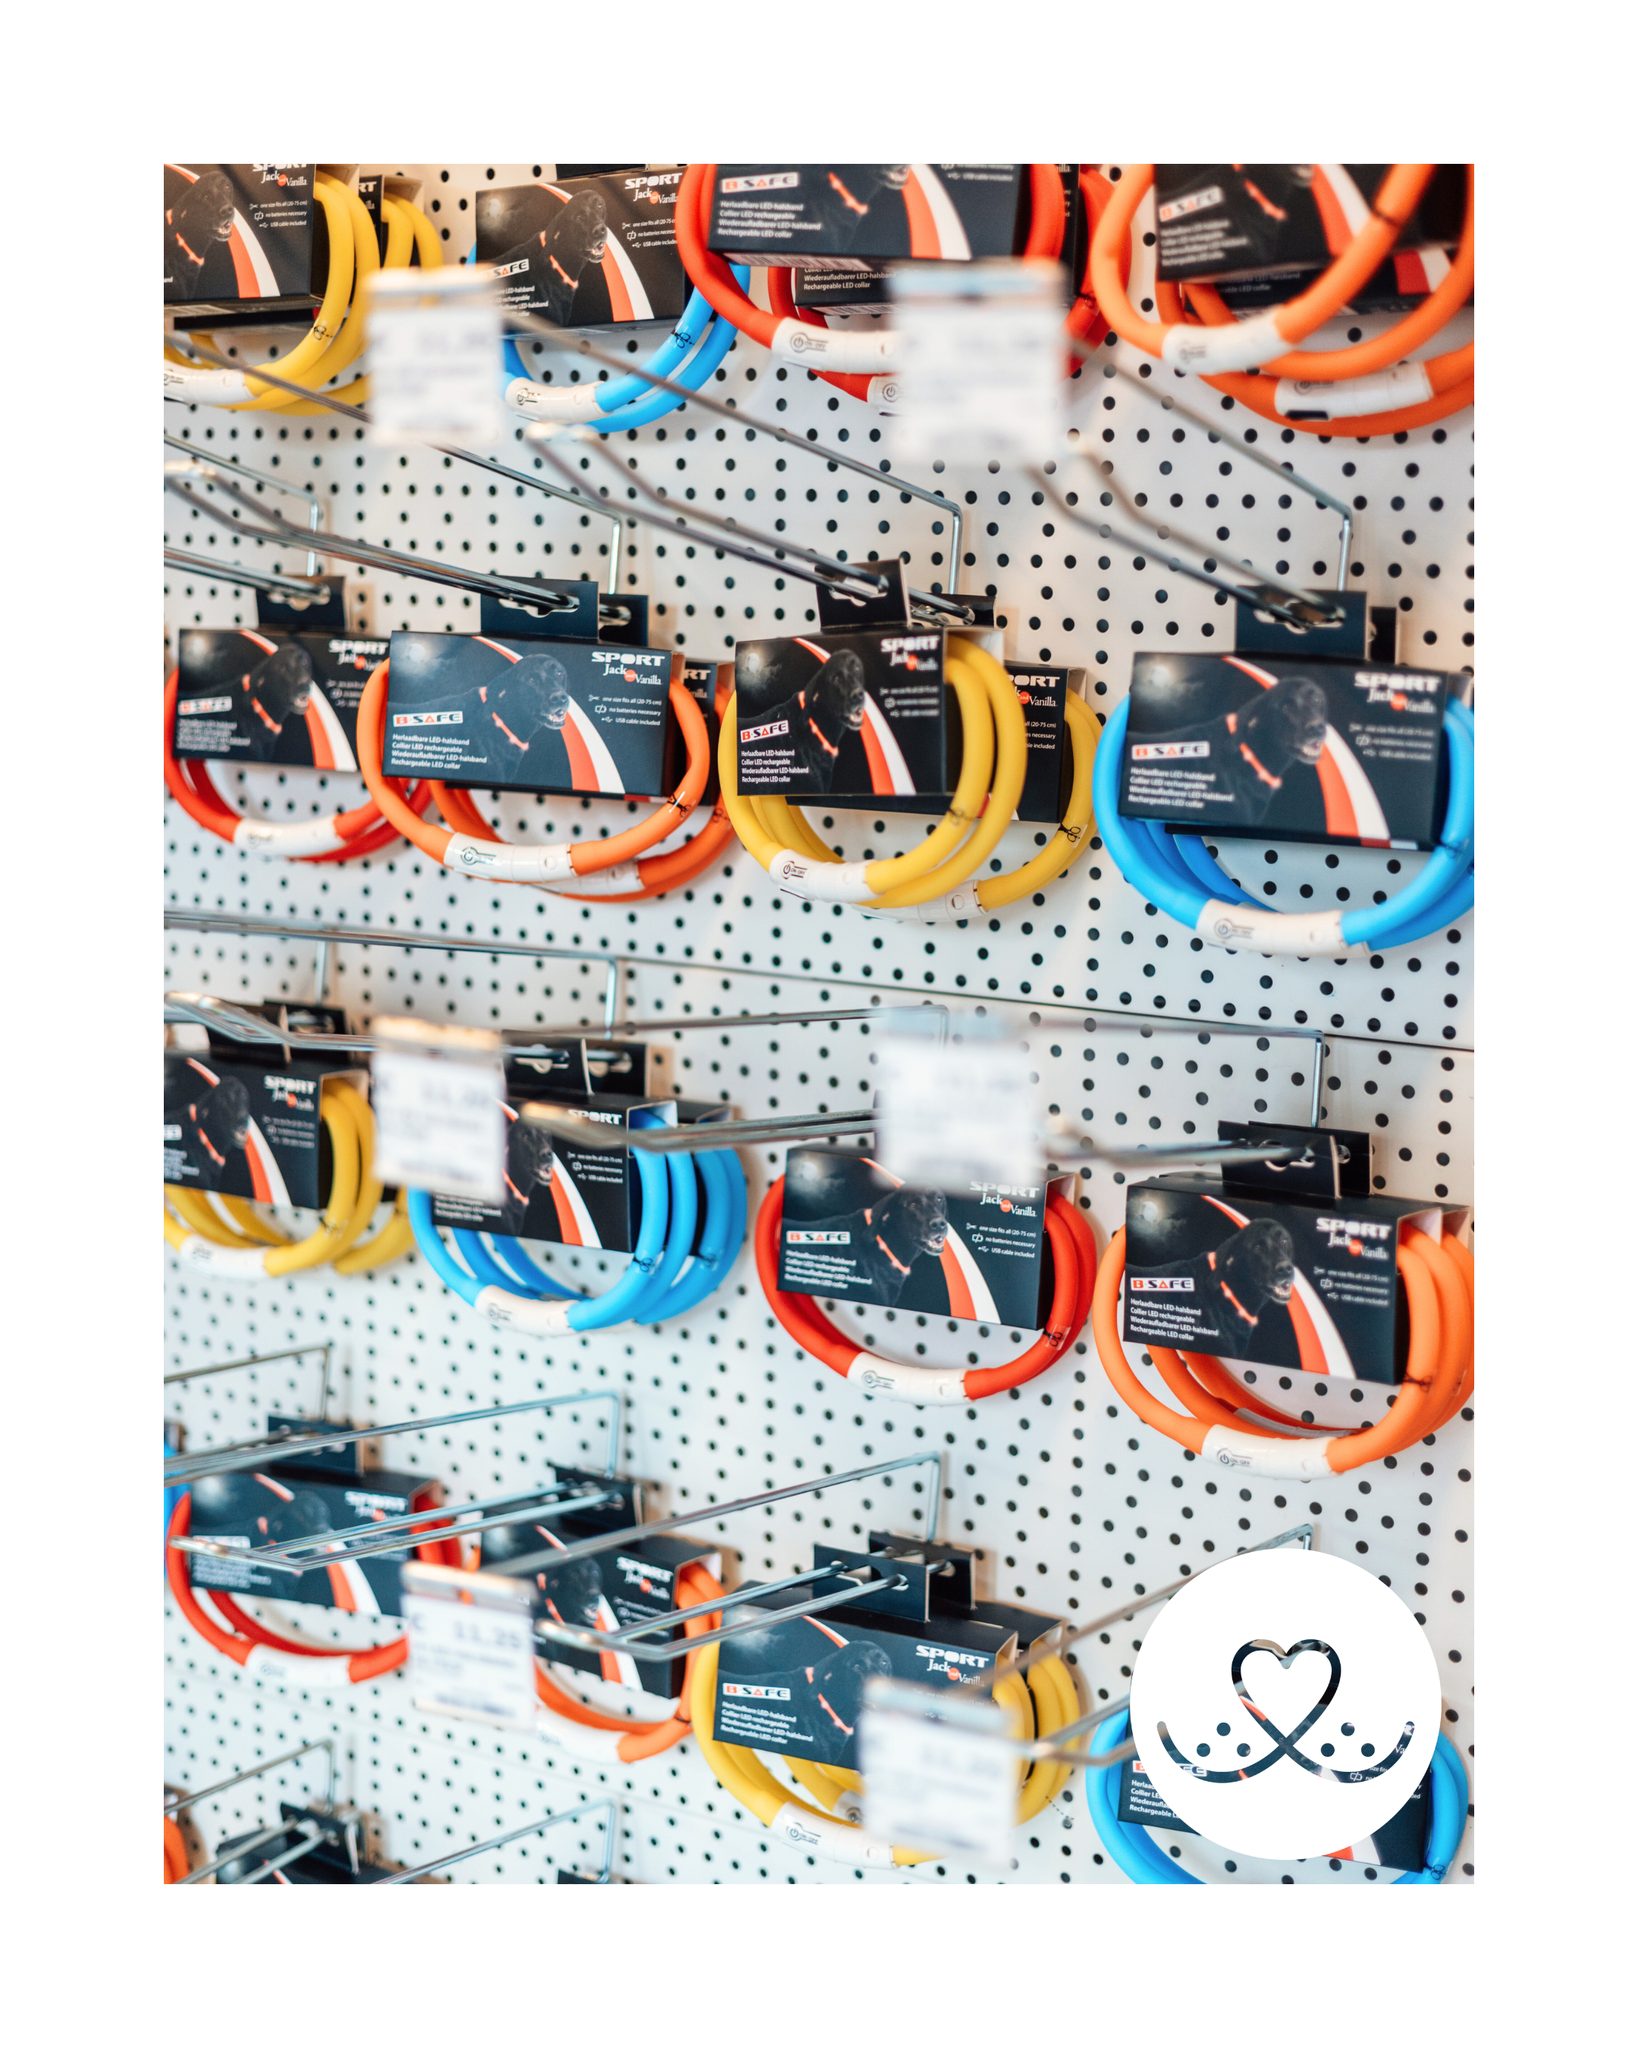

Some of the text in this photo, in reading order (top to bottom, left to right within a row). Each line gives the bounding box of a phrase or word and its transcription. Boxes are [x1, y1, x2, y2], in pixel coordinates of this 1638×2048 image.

[624, 173, 682, 189] SPORT
[633, 187, 652, 202] Jack
[881, 635, 940, 652] SPORT
[592, 651, 665, 666] SPORT
[603, 664, 627, 676] Jack
[635, 674, 661, 685] Vanilla
[1354, 672, 1441, 692] SPORT
[1030, 696, 1056, 706] Vanilla
[429, 736, 470, 745] LED-halsband
[424, 745, 462, 753] rechargeable
[391, 758, 431, 767] Rechargeable
[447, 754, 487, 763] LED-halsband
[969, 1181, 1039, 1198] SPORT
[980, 1193, 1002, 1205] Jack
[1011, 1205, 1036, 1217] Vanilla
[1316, 1217, 1392, 1239] SPORT
[1328, 1232, 1351, 1247] Jack
[1360, 1246, 1389, 1260] Vanilla
[1131, 1307, 1147, 1315] Collier
[1159, 1312, 1195, 1323] rechargeable
[1163, 1303, 1202, 1315] LED-halsband
[1131, 1324, 1166, 1336] Rechargeable
[1179, 1332, 1194, 1340] collar
[1180, 1324, 1219, 1336] LED-halsband
[916, 1645, 989, 1668] SPORT
[926, 1659, 950, 1672] Jack
[1131, 1788, 1150, 1796] Collier
[1130, 1804, 1171, 1816] Rechargeable
